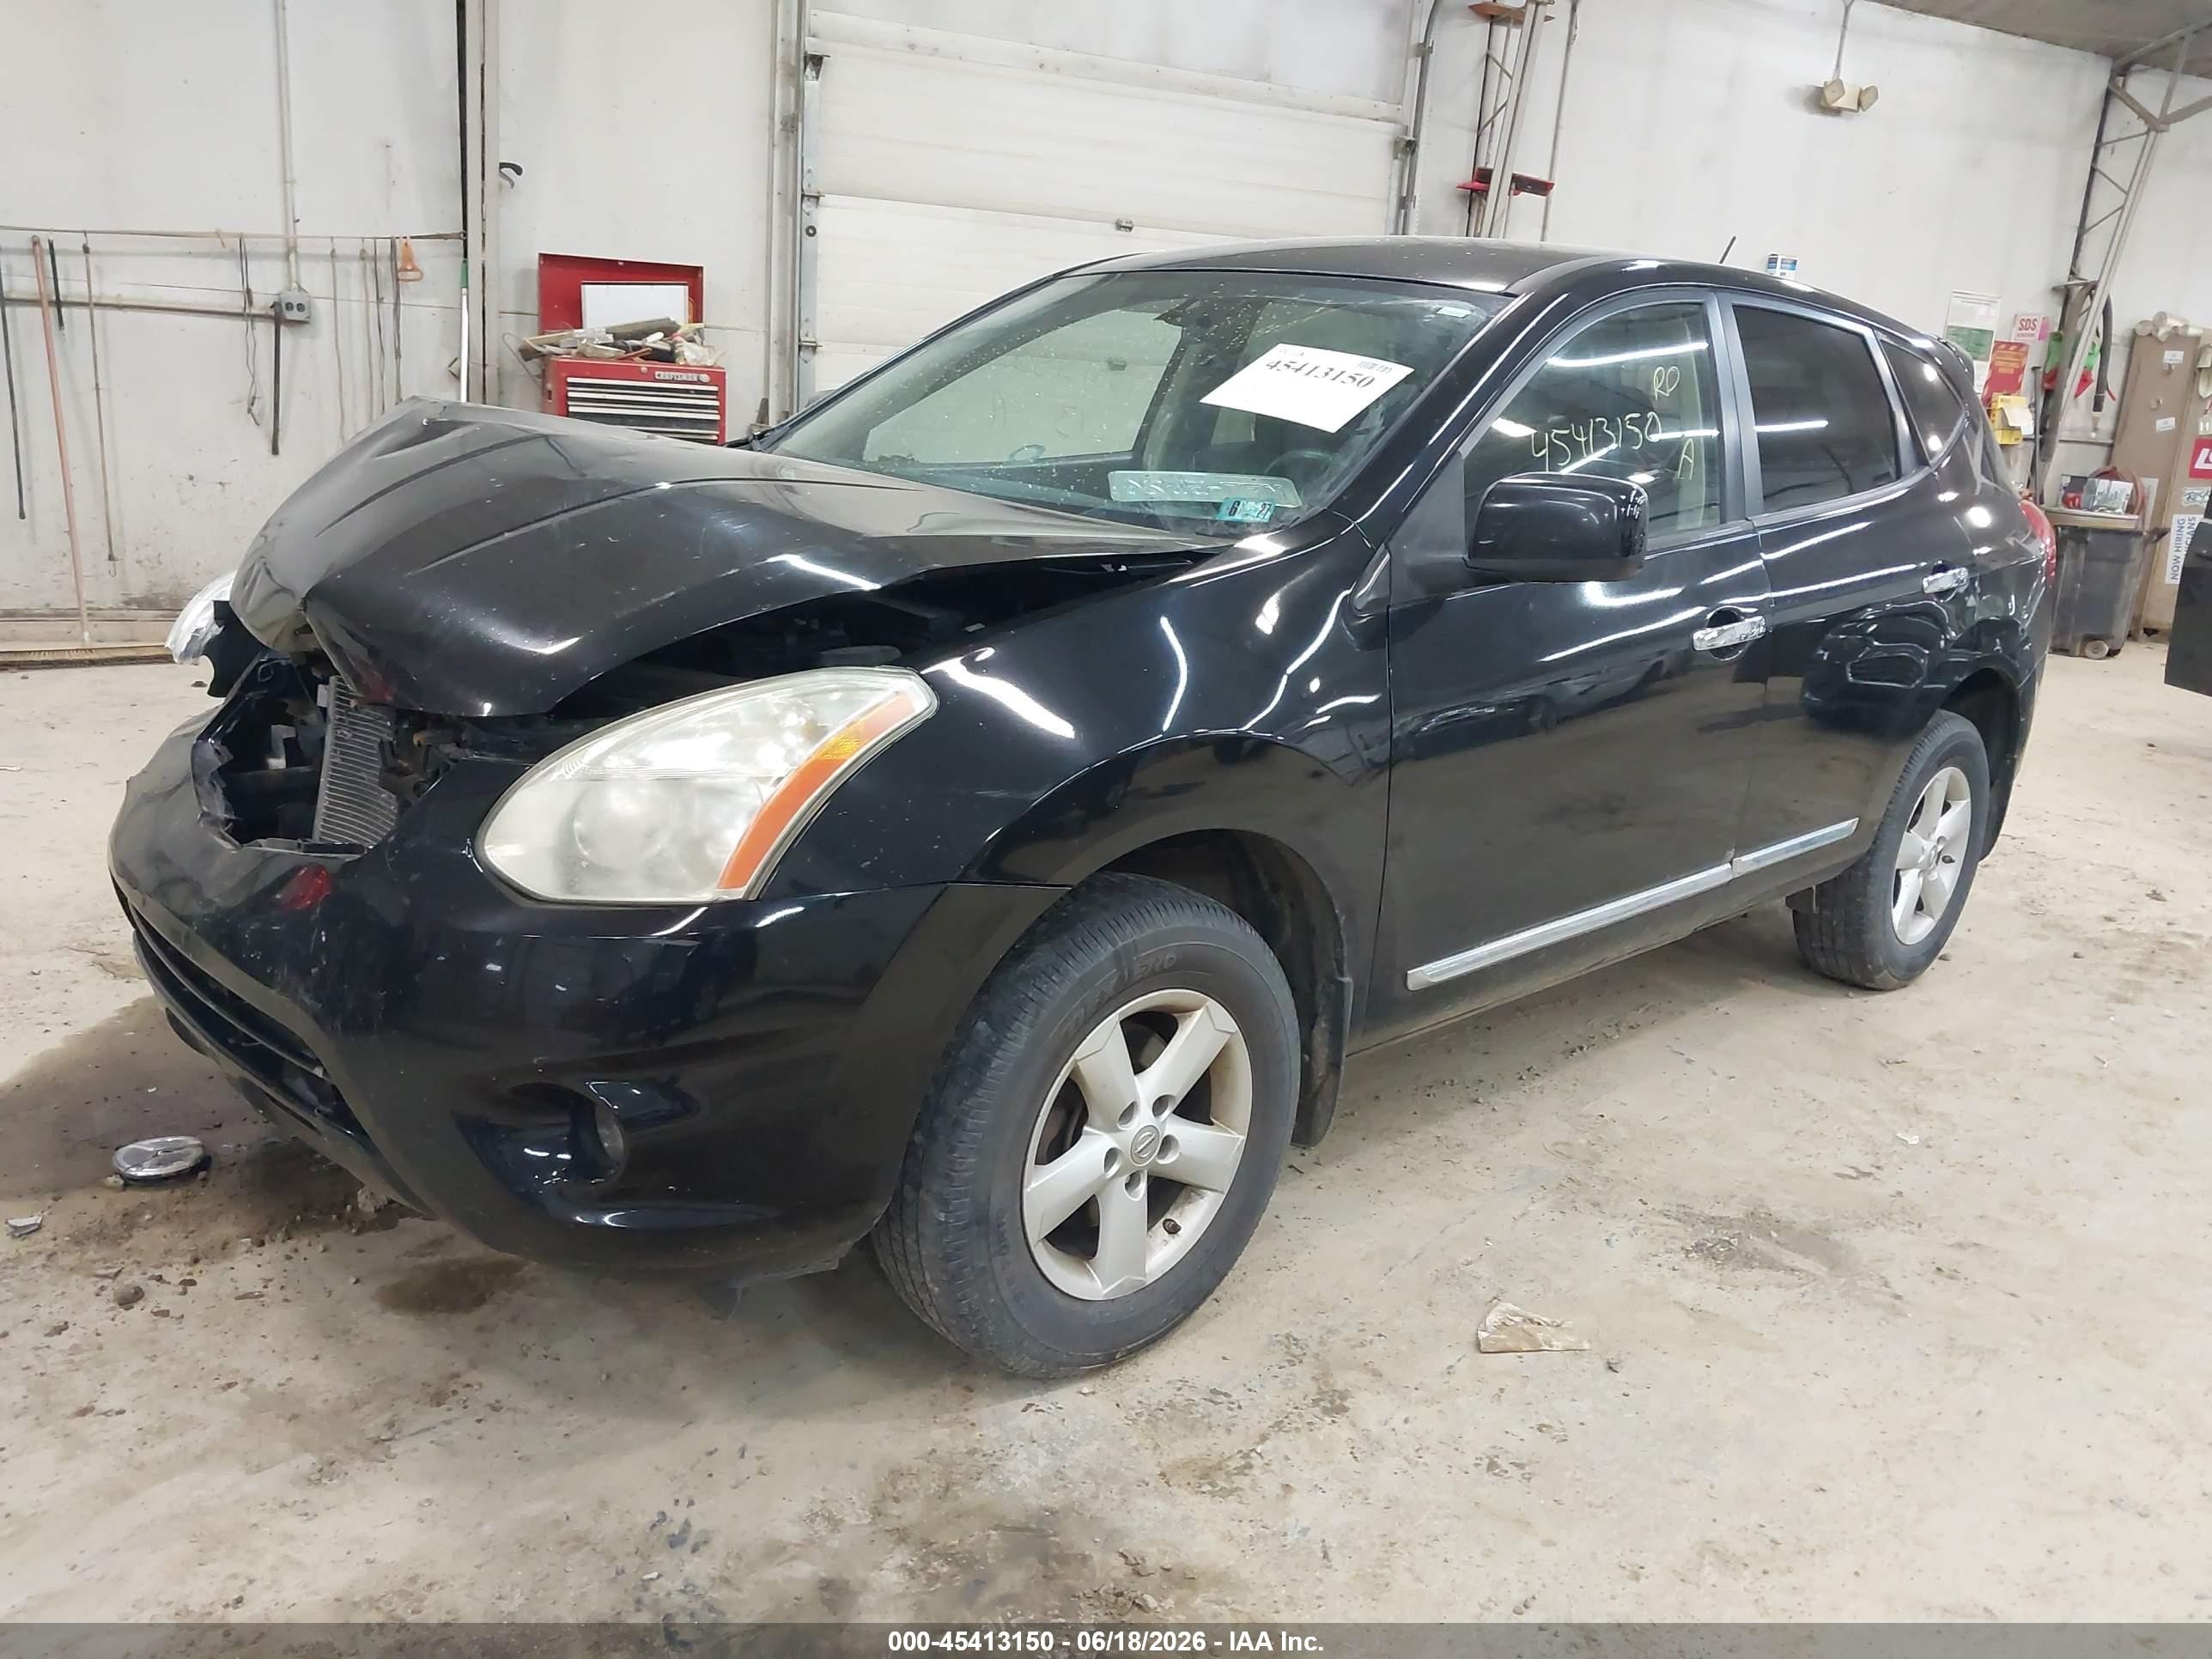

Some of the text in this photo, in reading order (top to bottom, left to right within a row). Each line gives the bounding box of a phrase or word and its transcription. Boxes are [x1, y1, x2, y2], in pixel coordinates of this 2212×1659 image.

[2018, 318, 2039, 331] SDS
[1266, 360, 1376, 388] 45413150
[1531, 411, 1662, 473] 45413150
[1677, 438, 1695, 480] A
[1228, 500, 1273, 520] 6 27
[2171, 518, 2185, 580] NOW HIRING
